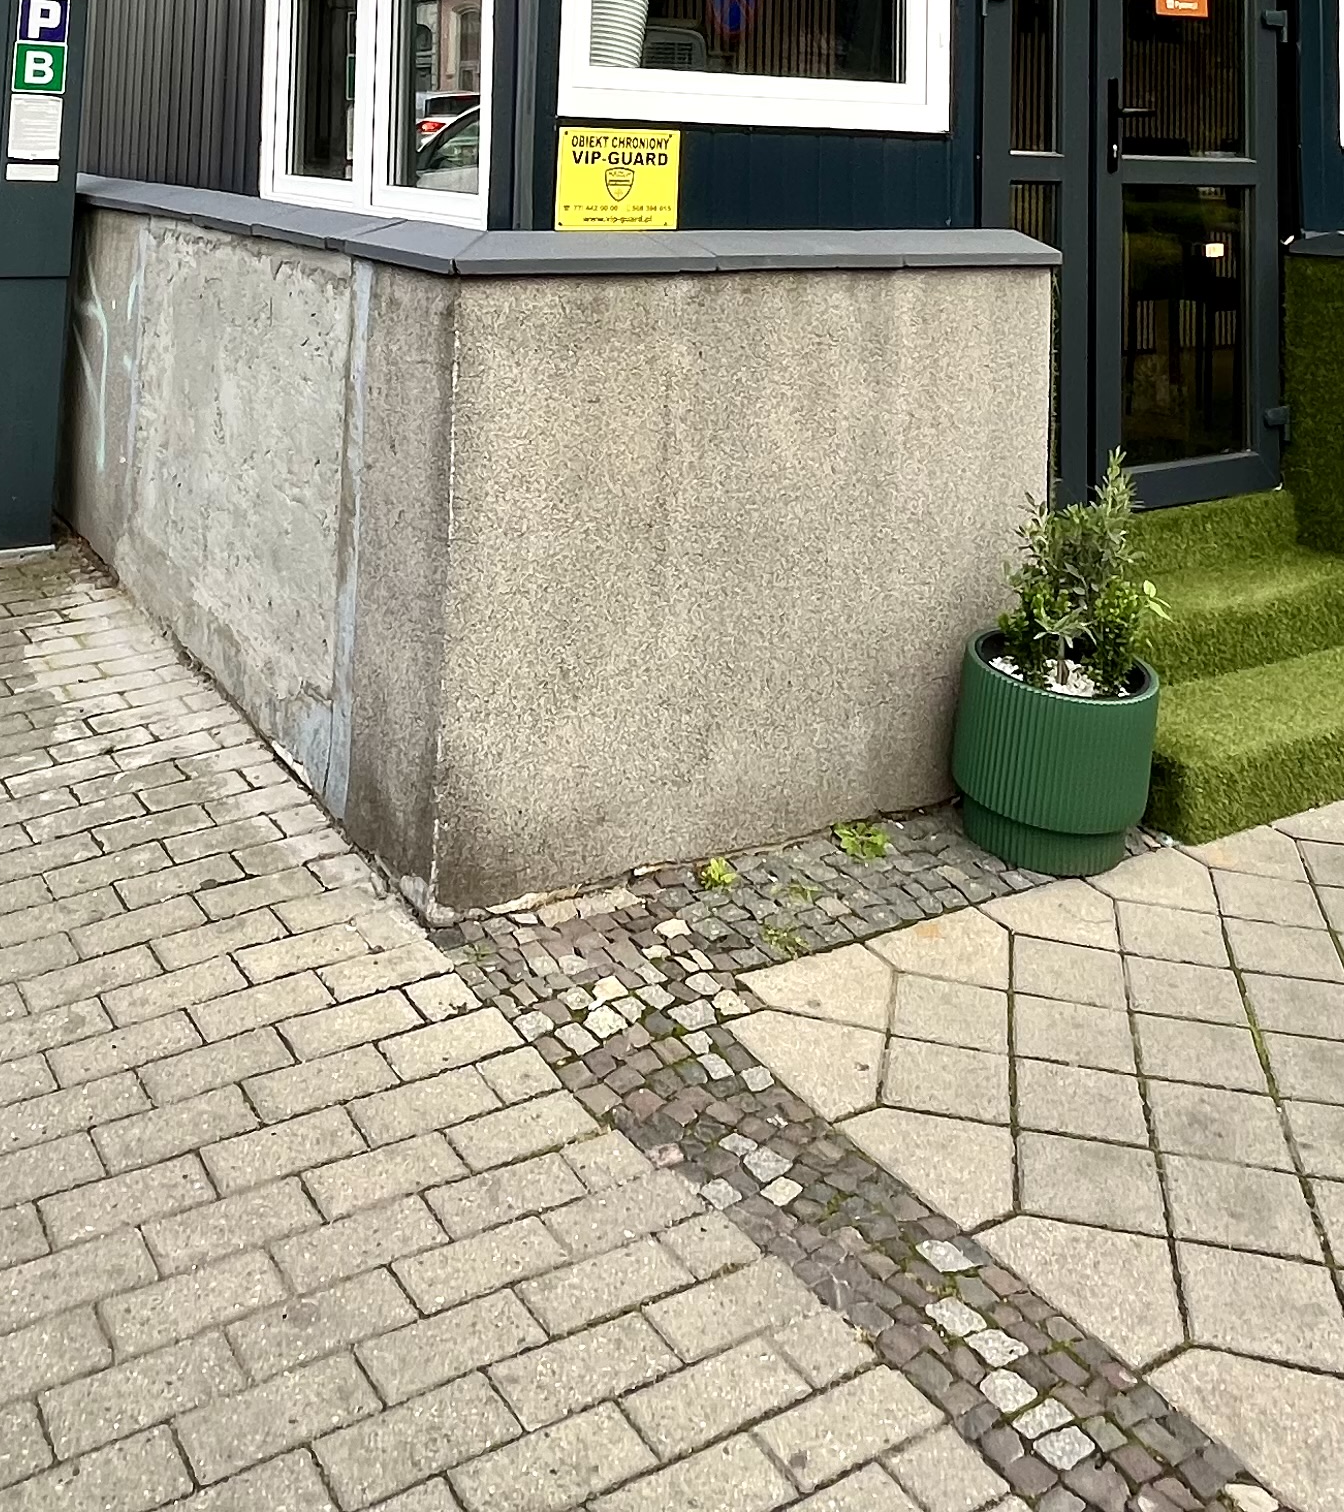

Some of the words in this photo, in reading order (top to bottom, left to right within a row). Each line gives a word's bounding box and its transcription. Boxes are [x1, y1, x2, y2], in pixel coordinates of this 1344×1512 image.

[24, 50, 54, 85] B
[571, 135, 609, 148] OBIEKT
[611, 136, 670, 150] CHRONIONY
[572, 150, 668, 166] VIP-GUARD
